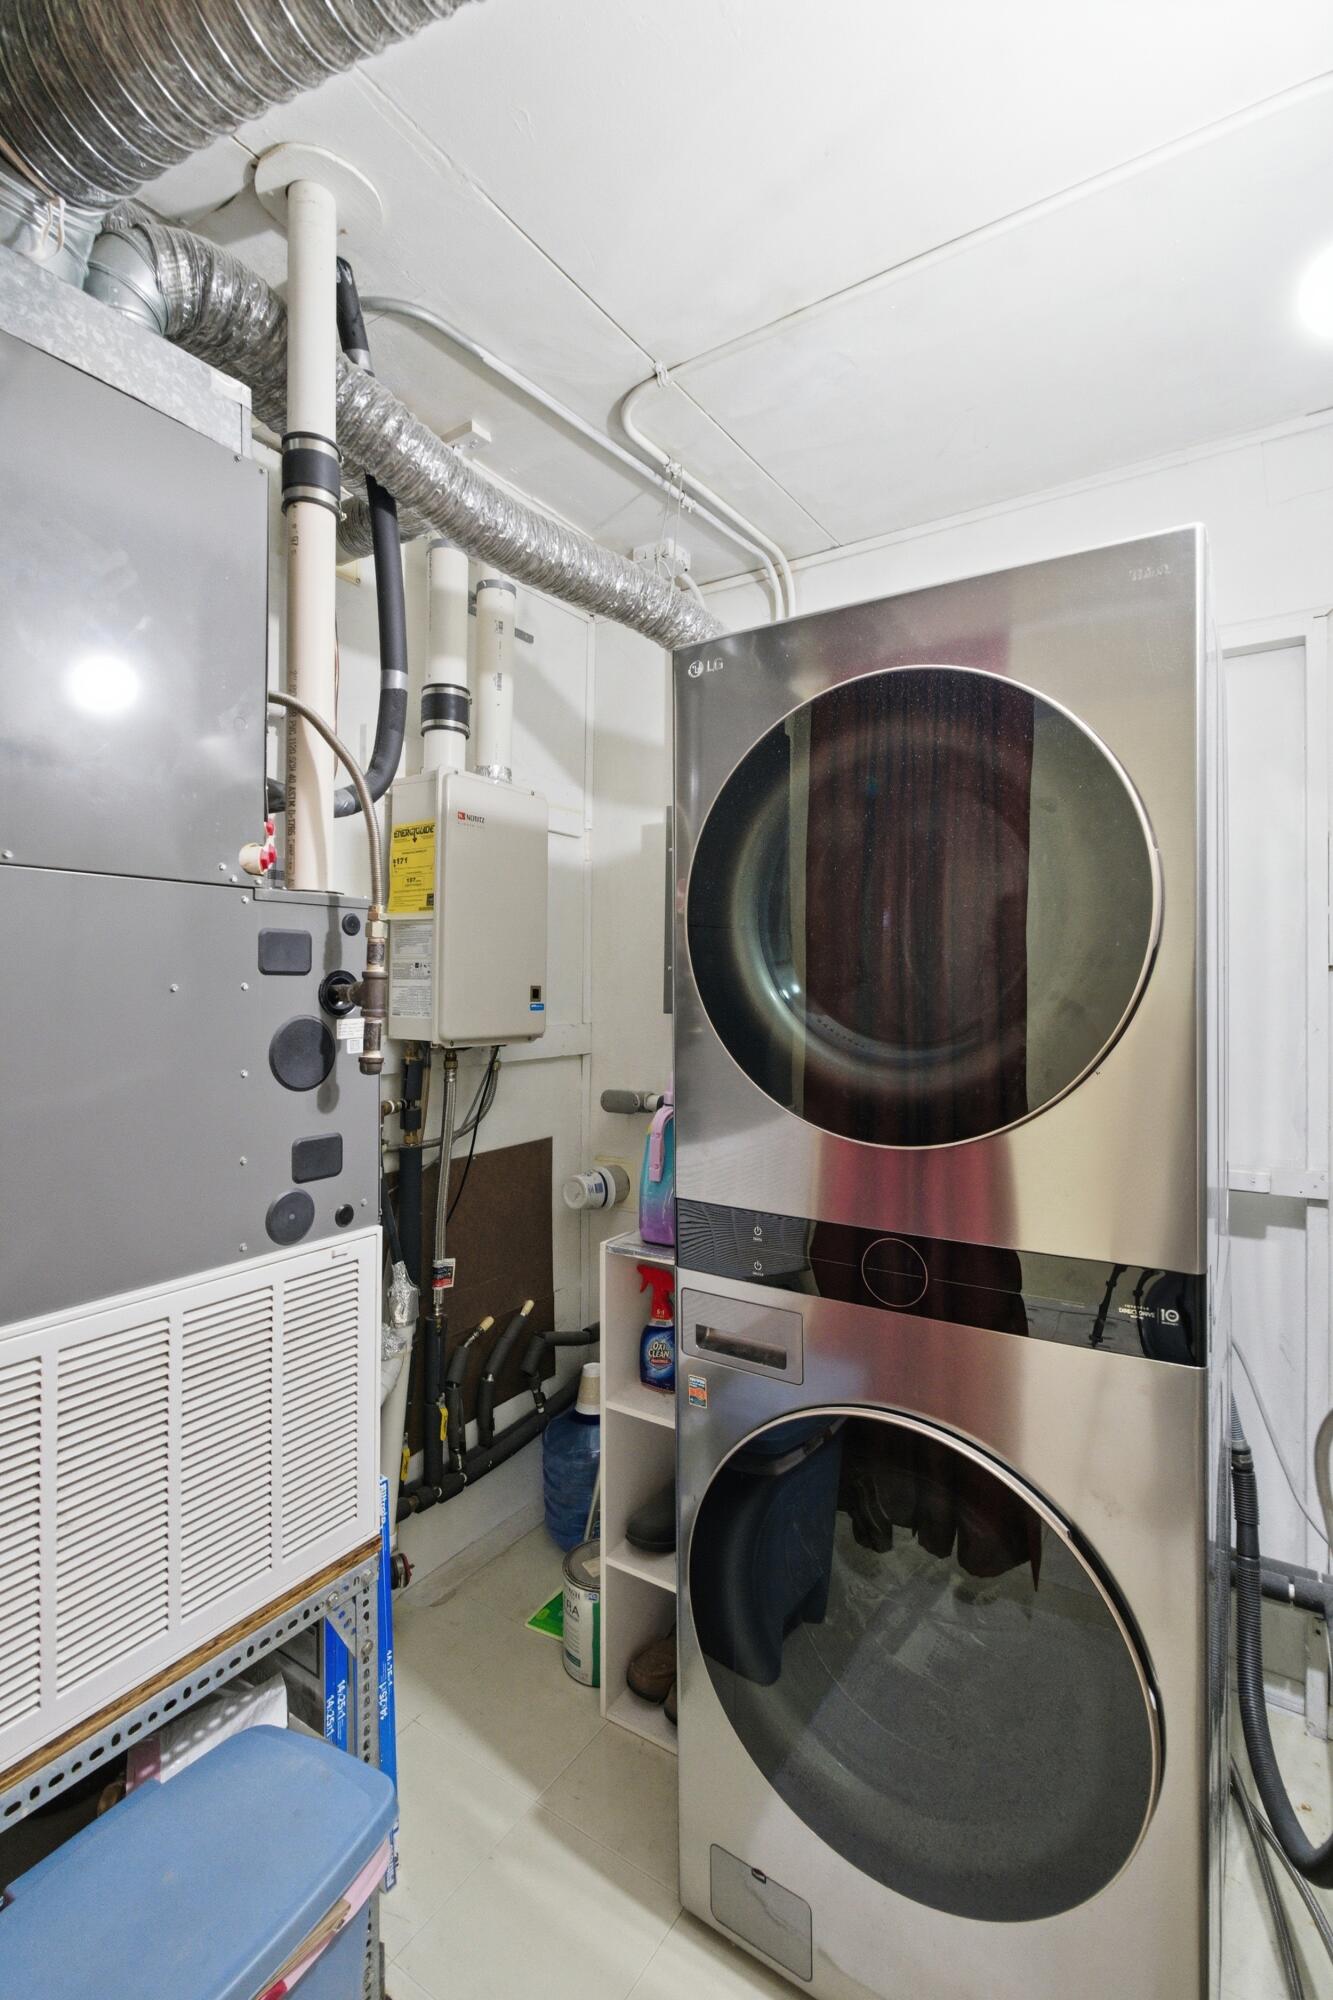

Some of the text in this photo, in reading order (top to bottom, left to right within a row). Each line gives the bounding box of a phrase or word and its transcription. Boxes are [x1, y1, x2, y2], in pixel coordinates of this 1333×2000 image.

[707, 657, 724, 672] LG
[288, 774, 297, 784] 40
[1161, 1308, 1180, 1323] 10
[652, 1341, 666, 1351] OXI
[648, 1348, 670, 1359] CLEAN
